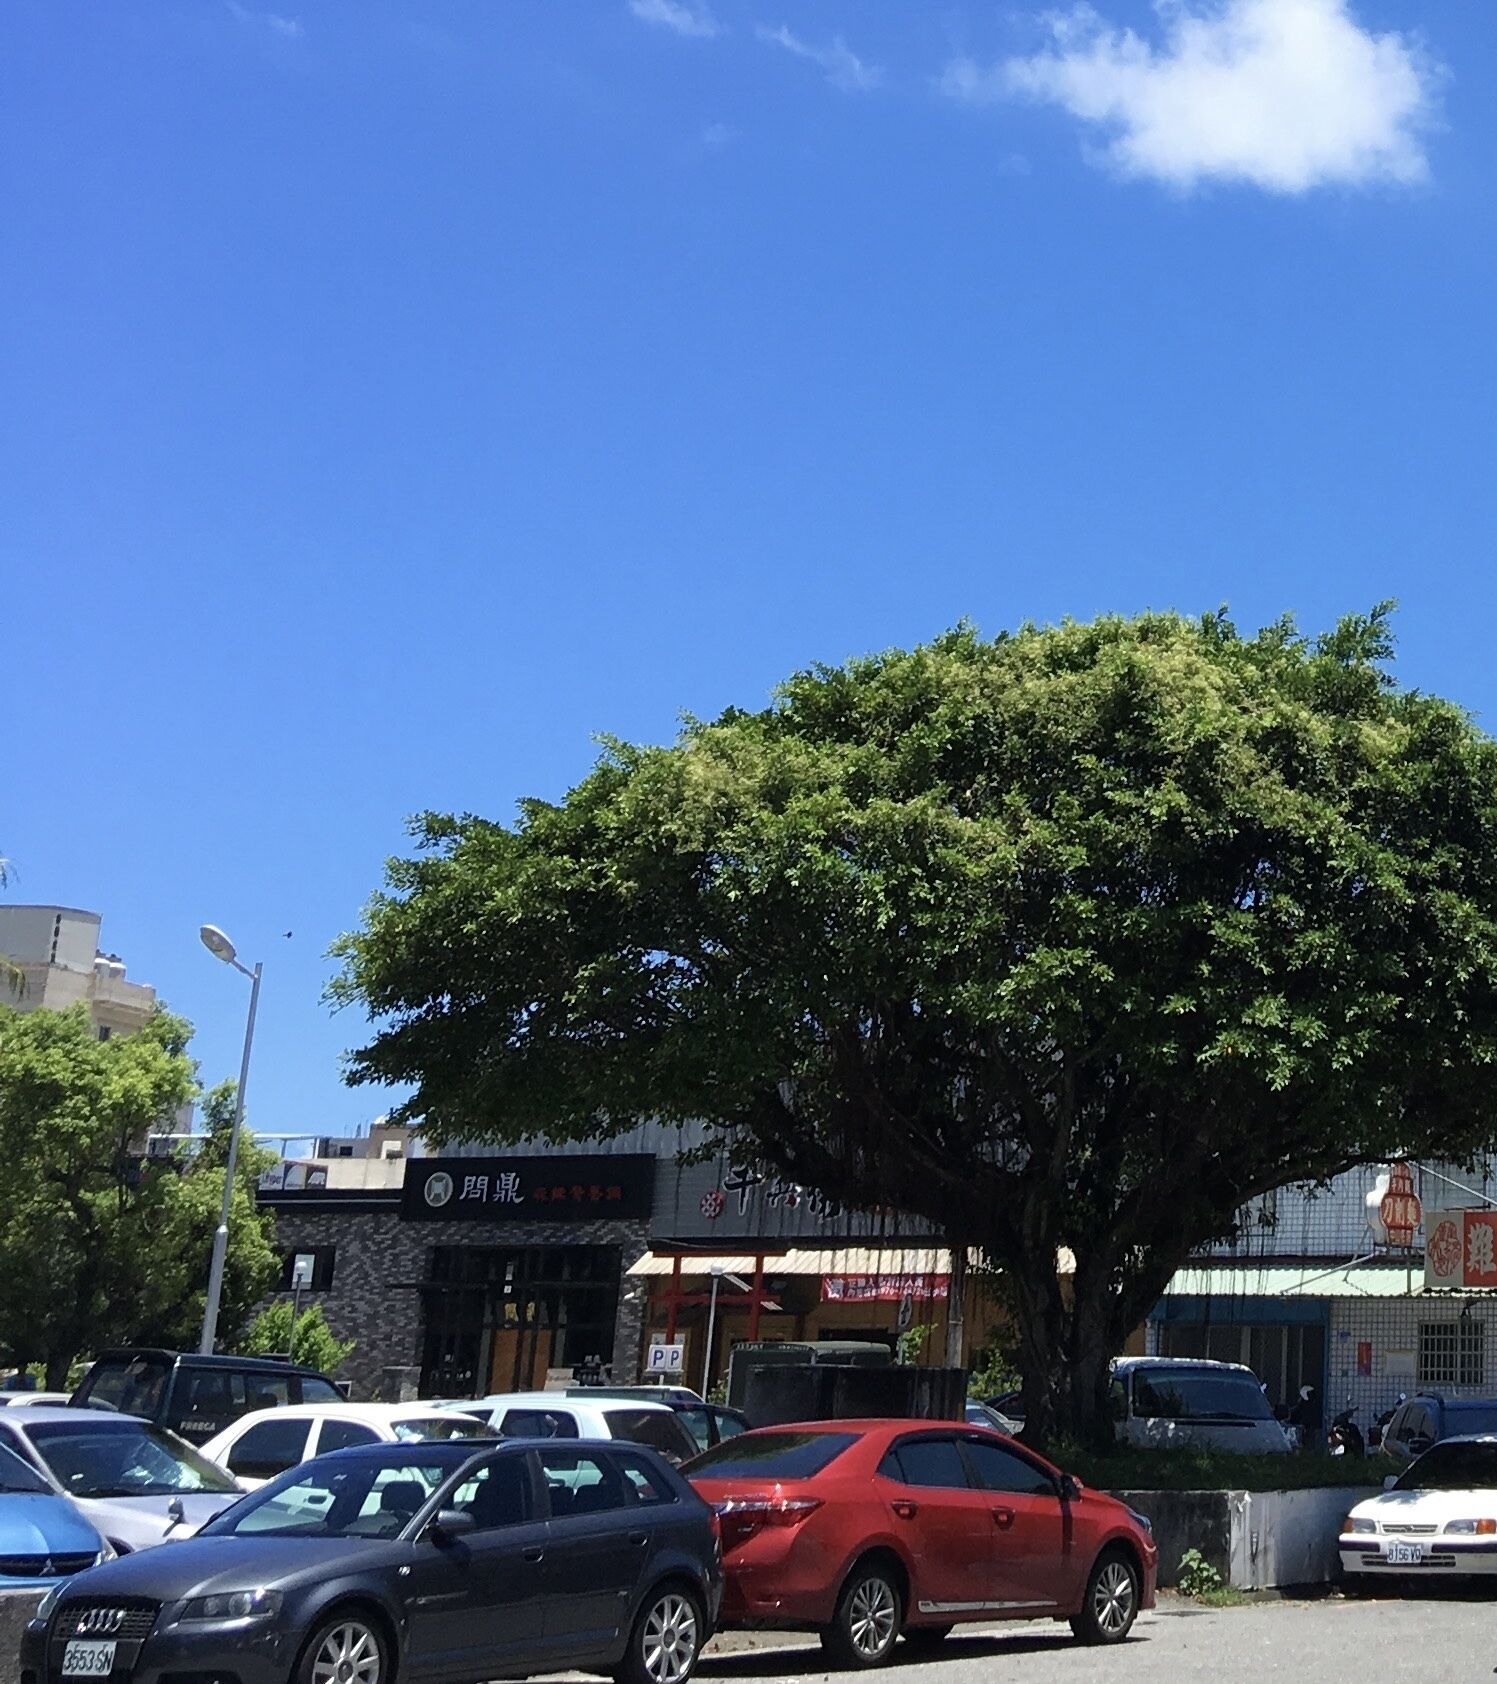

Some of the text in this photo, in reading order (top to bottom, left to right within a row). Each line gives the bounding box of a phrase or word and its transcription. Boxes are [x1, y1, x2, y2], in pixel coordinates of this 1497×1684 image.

[459, 1172, 525, 1204] 問鼎
[1382, 1197, 1419, 1228] 刀削麵
[653, 1349, 680, 1366] P P
